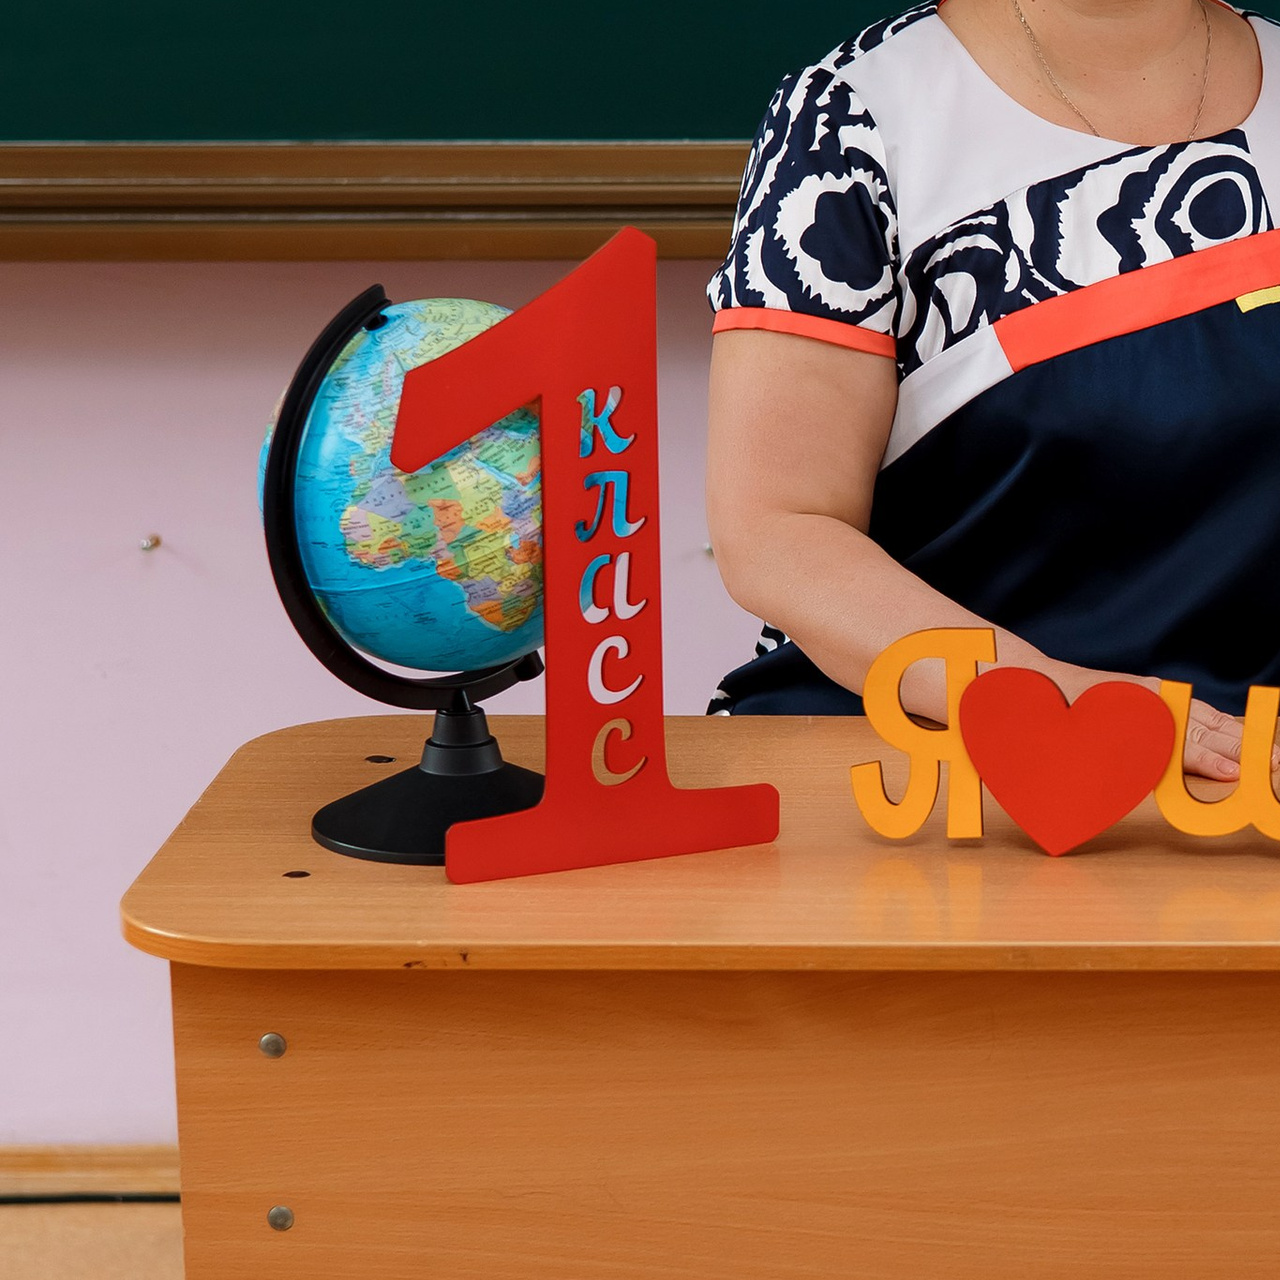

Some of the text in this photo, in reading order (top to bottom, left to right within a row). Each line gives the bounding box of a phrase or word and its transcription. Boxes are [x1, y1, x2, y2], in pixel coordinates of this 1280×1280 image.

[390, 225, 780, 884] 1
[574, 385, 649, 787] класс
[850, 627, 998, 839] Я
